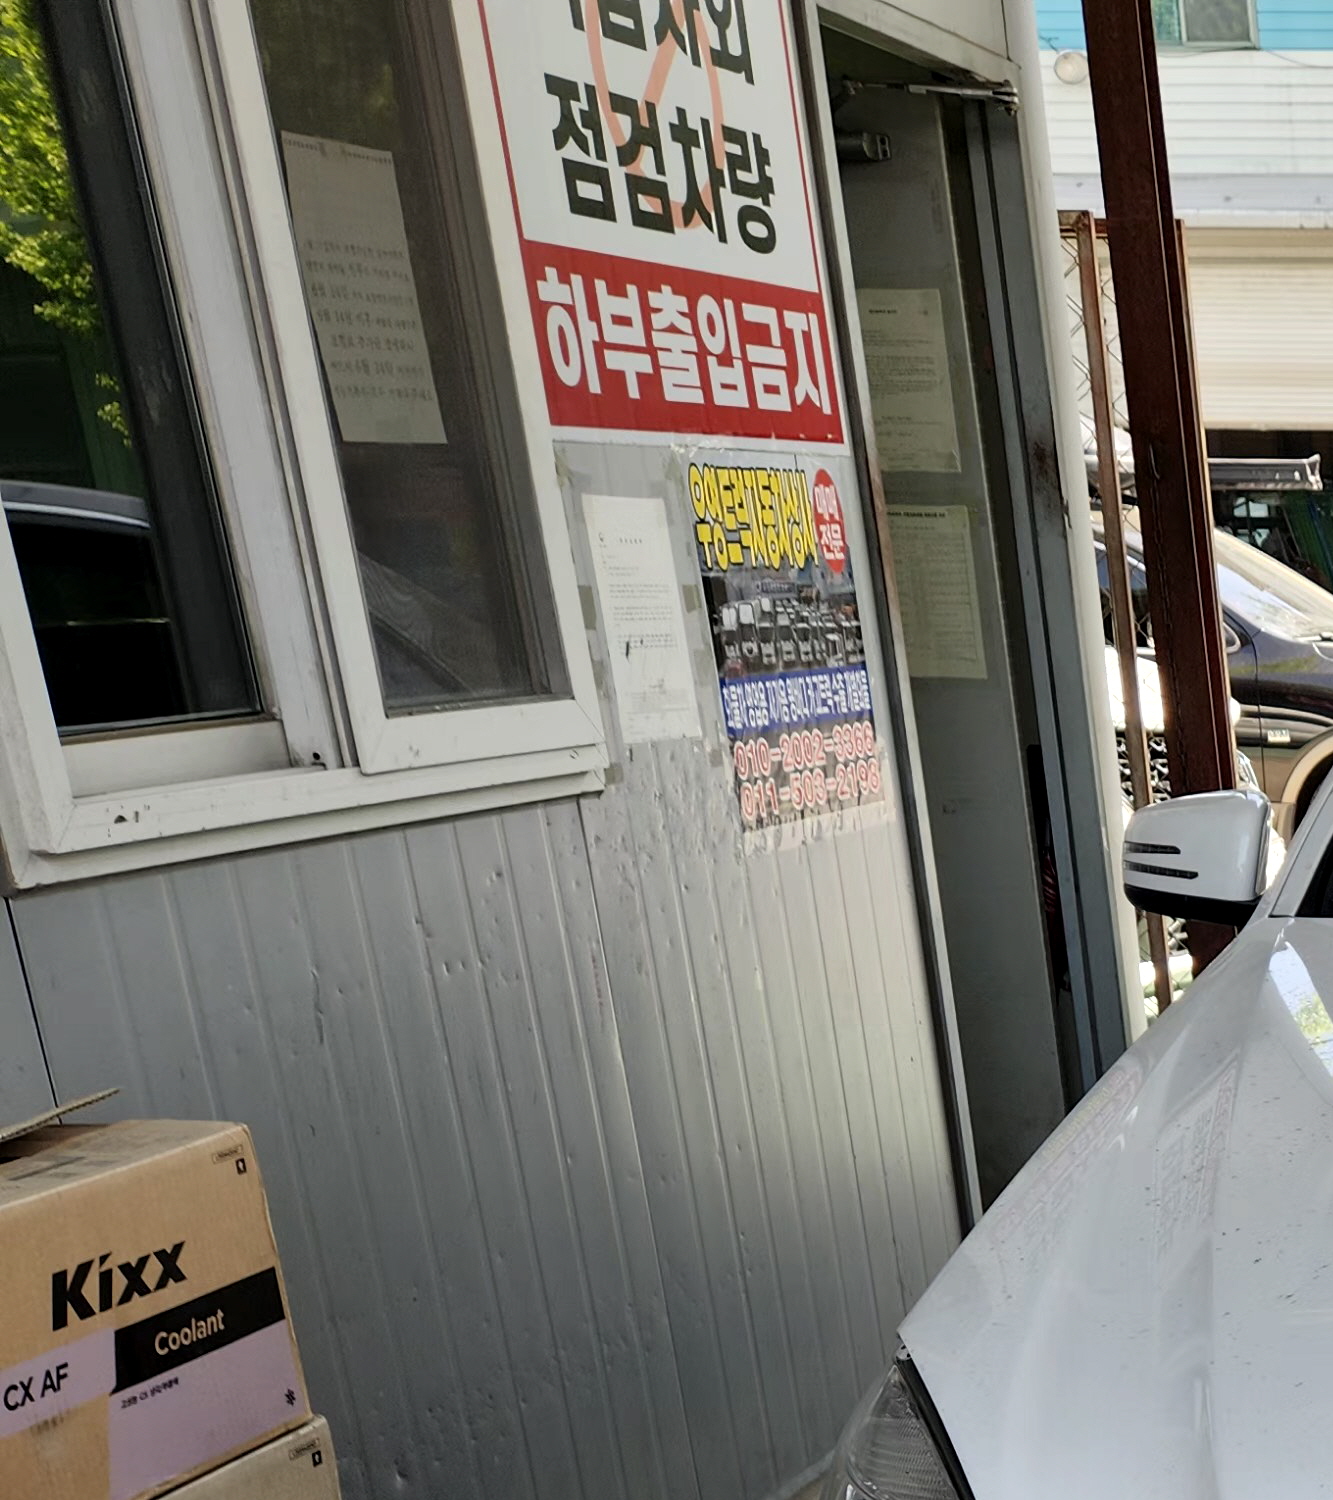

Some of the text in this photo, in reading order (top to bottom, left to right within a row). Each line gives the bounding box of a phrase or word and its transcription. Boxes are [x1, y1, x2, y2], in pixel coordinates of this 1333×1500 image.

[543, 72, 777, 255] 점검차량
[536, 266, 832, 415] 하부출입금지
[814, 484, 840, 521] 매매
[819, 522, 846, 561] 전문
[734, 720, 876, 780] 010-2002-3366
[52, 1240, 188, 1332] Kixx
[154, 1308, 226, 1356] Coolant
[3, 1361, 69, 1412] CX AF
